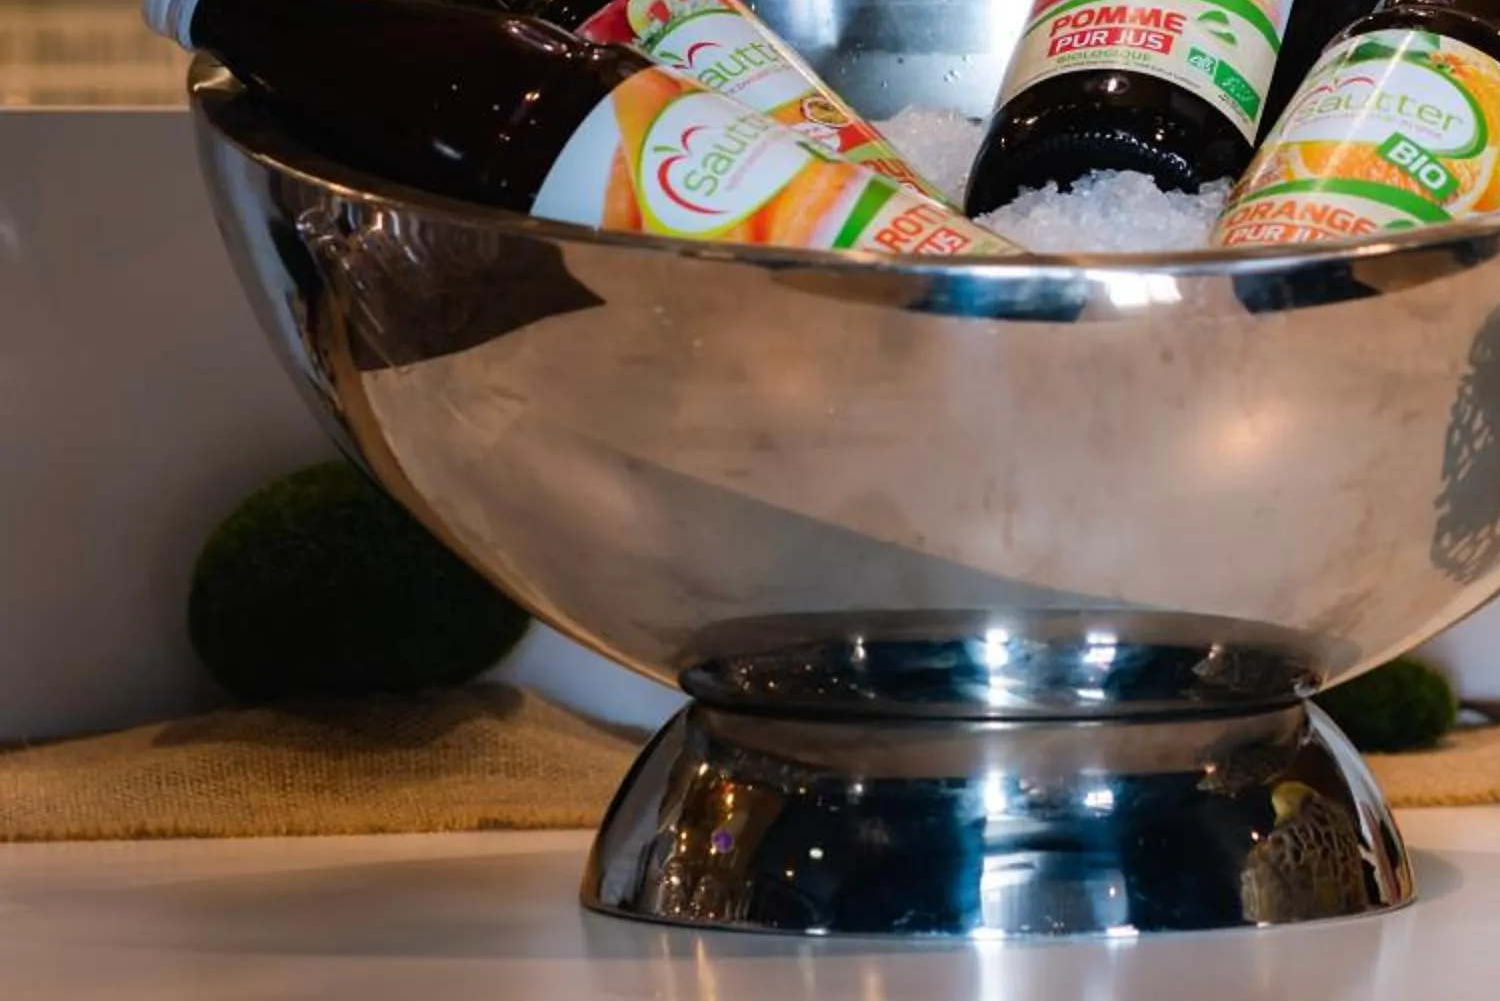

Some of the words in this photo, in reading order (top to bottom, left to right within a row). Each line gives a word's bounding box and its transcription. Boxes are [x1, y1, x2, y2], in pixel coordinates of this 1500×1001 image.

[1050, 5, 1187, 37] POMME
[1056, 30, 1107, 52] PUR
[1113, 30, 1166, 49] JUS
[1387, 137, 1448, 190] BIO
[1223, 200, 1377, 236] ORANGE
[1228, 224, 1286, 243] PUR
